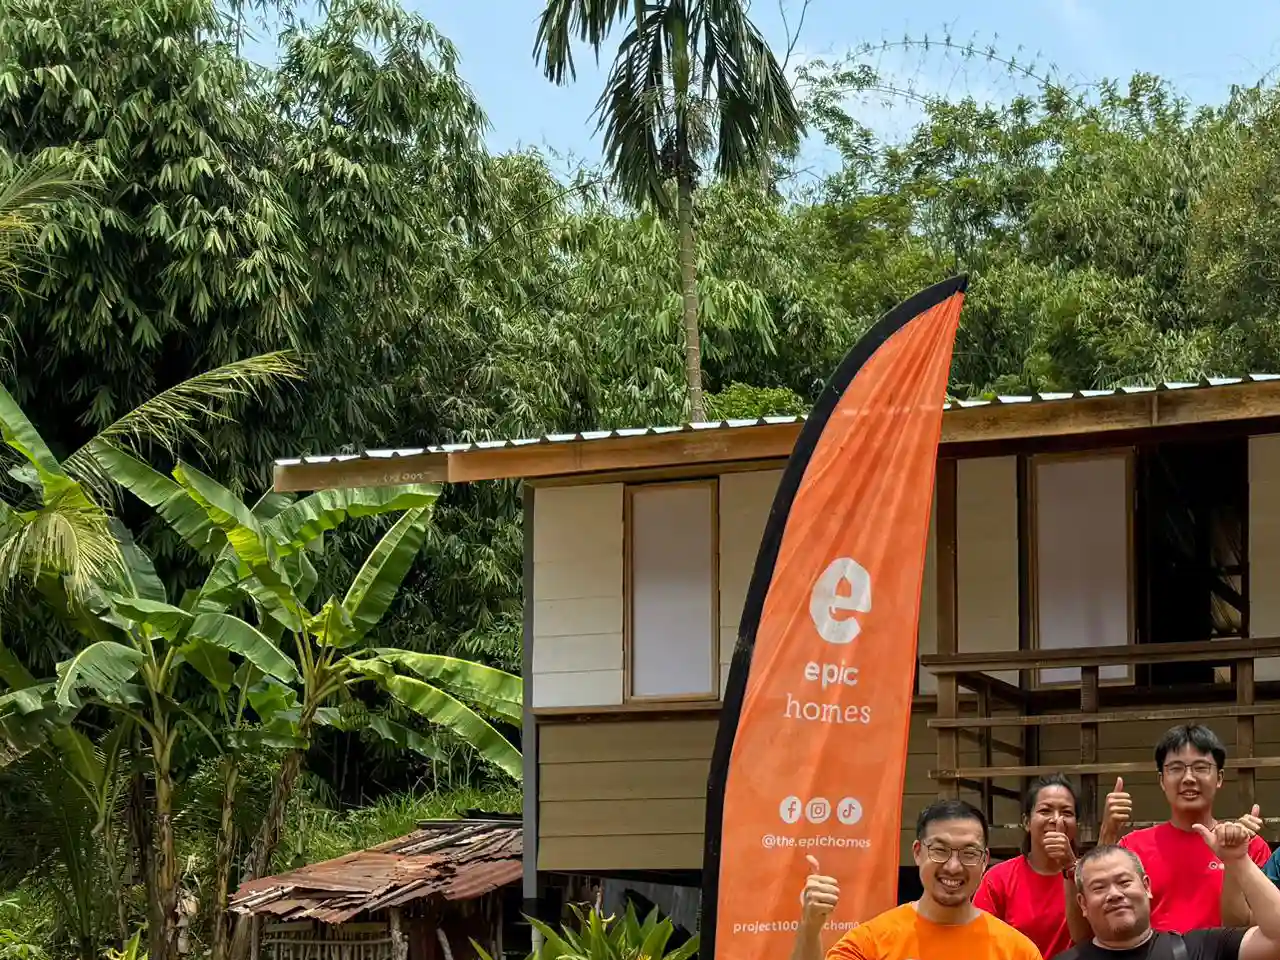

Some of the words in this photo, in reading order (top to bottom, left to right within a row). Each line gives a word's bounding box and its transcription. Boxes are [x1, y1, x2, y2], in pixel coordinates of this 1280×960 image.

[809, 557, 872, 643] e
[804, 657, 859, 691] epic
[783, 692, 871, 724] homes
[761, 834, 872, 849] @the.epichomes
